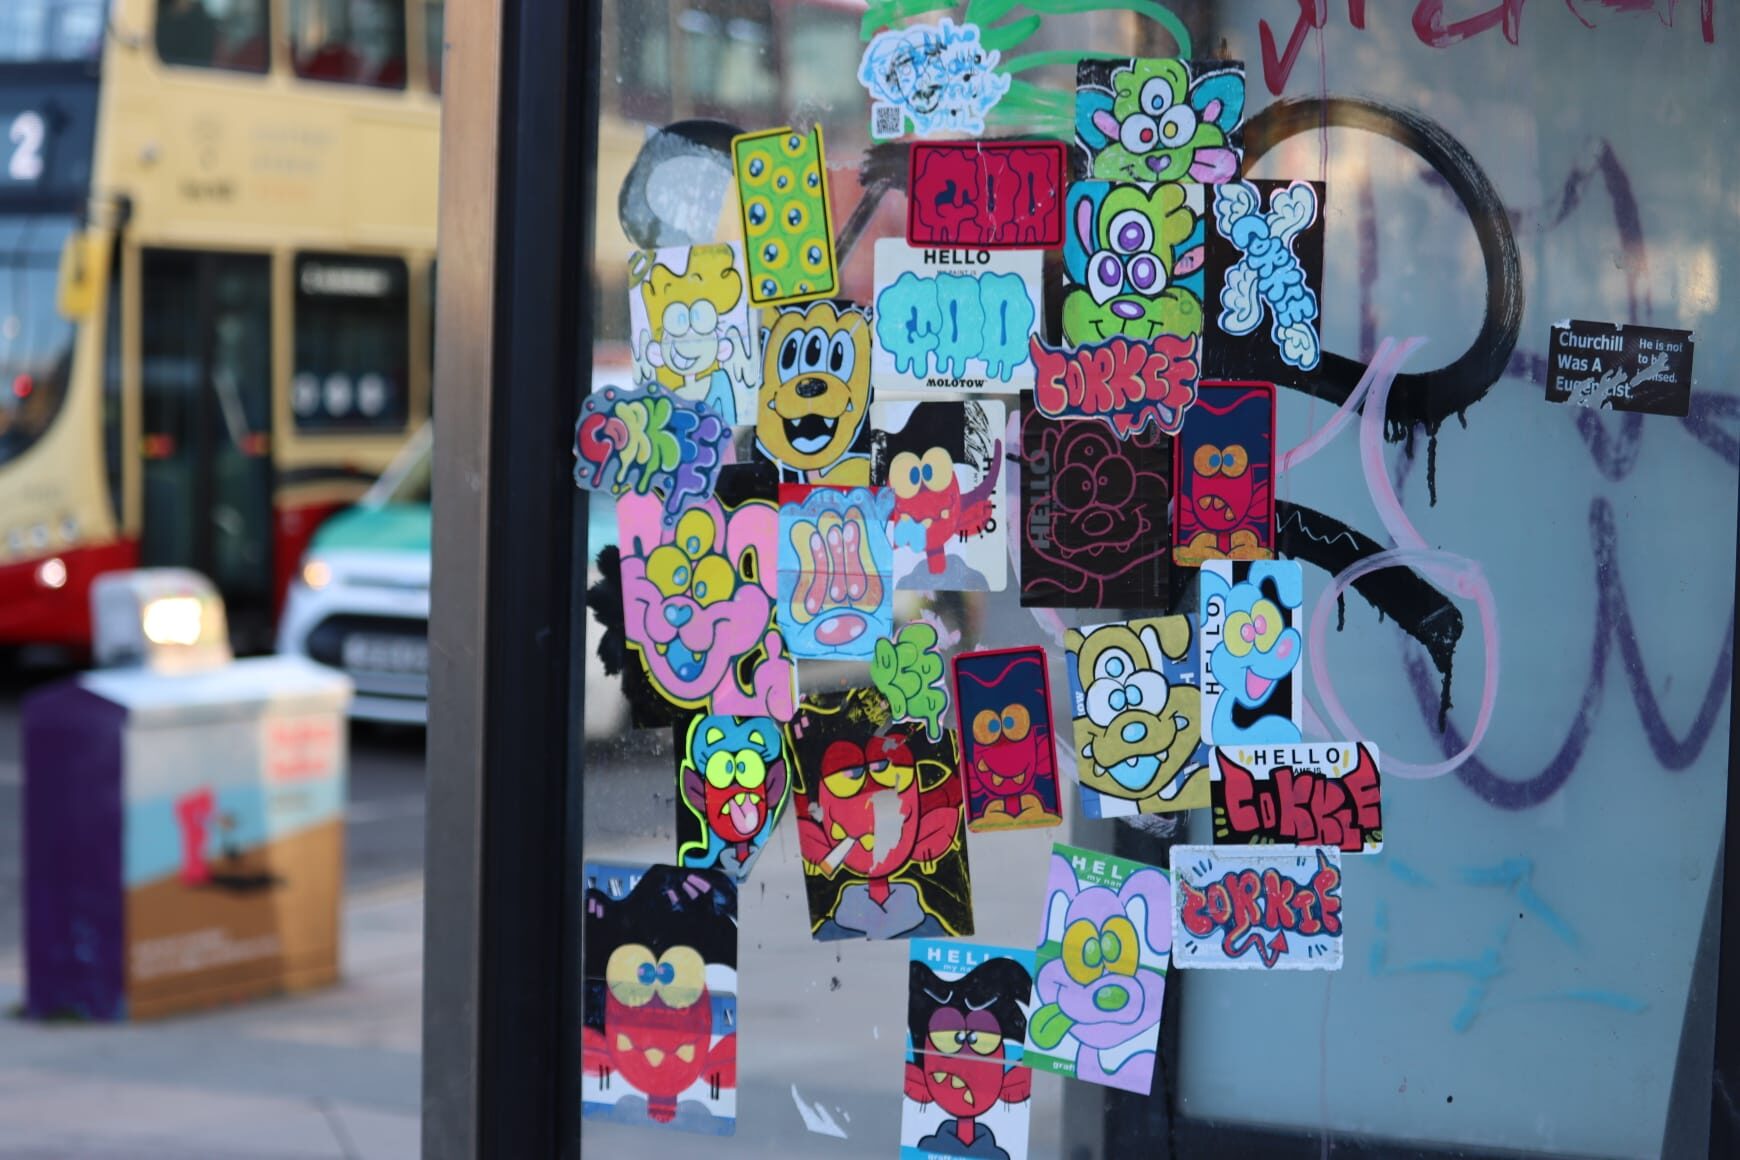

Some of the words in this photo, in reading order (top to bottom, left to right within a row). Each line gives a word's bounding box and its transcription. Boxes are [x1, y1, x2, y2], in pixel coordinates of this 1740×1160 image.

[9, 110, 45, 180] 2
[924, 248, 991, 264] HELLO
[1559, 330, 1624, 352] Churchill
[1640, 338, 1653, 350] He
[1655, 339, 1664, 350] is
[1557, 353, 1588, 372] Was
[1591, 357, 1602, 373] A
[1638, 353, 1649, 364] to
[926, 378, 985, 388] MOLOTOW
[1030, 449, 1049, 549] HELLO
[1254, 747, 1340, 765] HELLO
[1072, 855, 1135, 880] HEL
